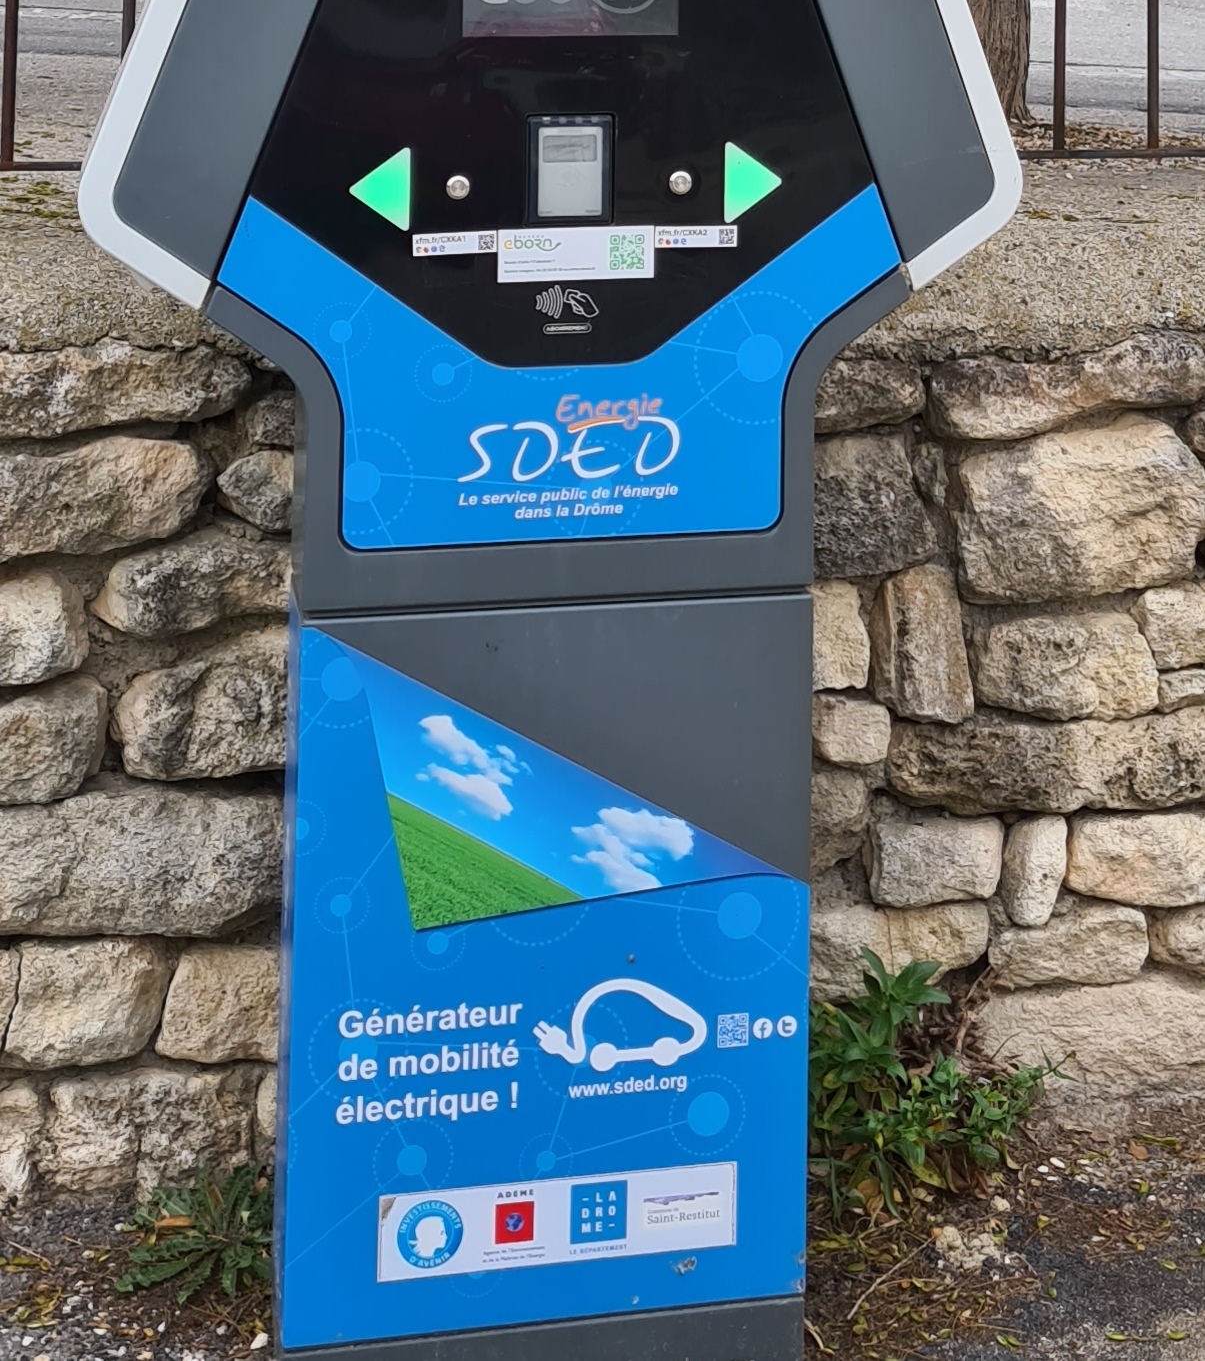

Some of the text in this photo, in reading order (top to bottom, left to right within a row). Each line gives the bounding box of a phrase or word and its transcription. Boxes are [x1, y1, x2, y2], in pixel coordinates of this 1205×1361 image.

[556, 392, 663, 431] Energie
[457, 416, 681, 483] SDED
[458, 482, 679, 506] Le service public de l'énergie
[514, 502, 624, 519] dans la Drôme
[338, 1002, 523, 1039] Générateur
[338, 1039, 519, 1082] de mobilité
[568, 1074, 688, 1099] www.sded.org
[335, 1089, 499, 1125] électrique
[497, 1189, 534, 1199] ADEME
[400, 1201, 462, 1234] INVESTISSEMENTS
[647, 1209, 720, 1224] Saint-Restitut
[409, 1252, 451, 1267] D'AVENIR
